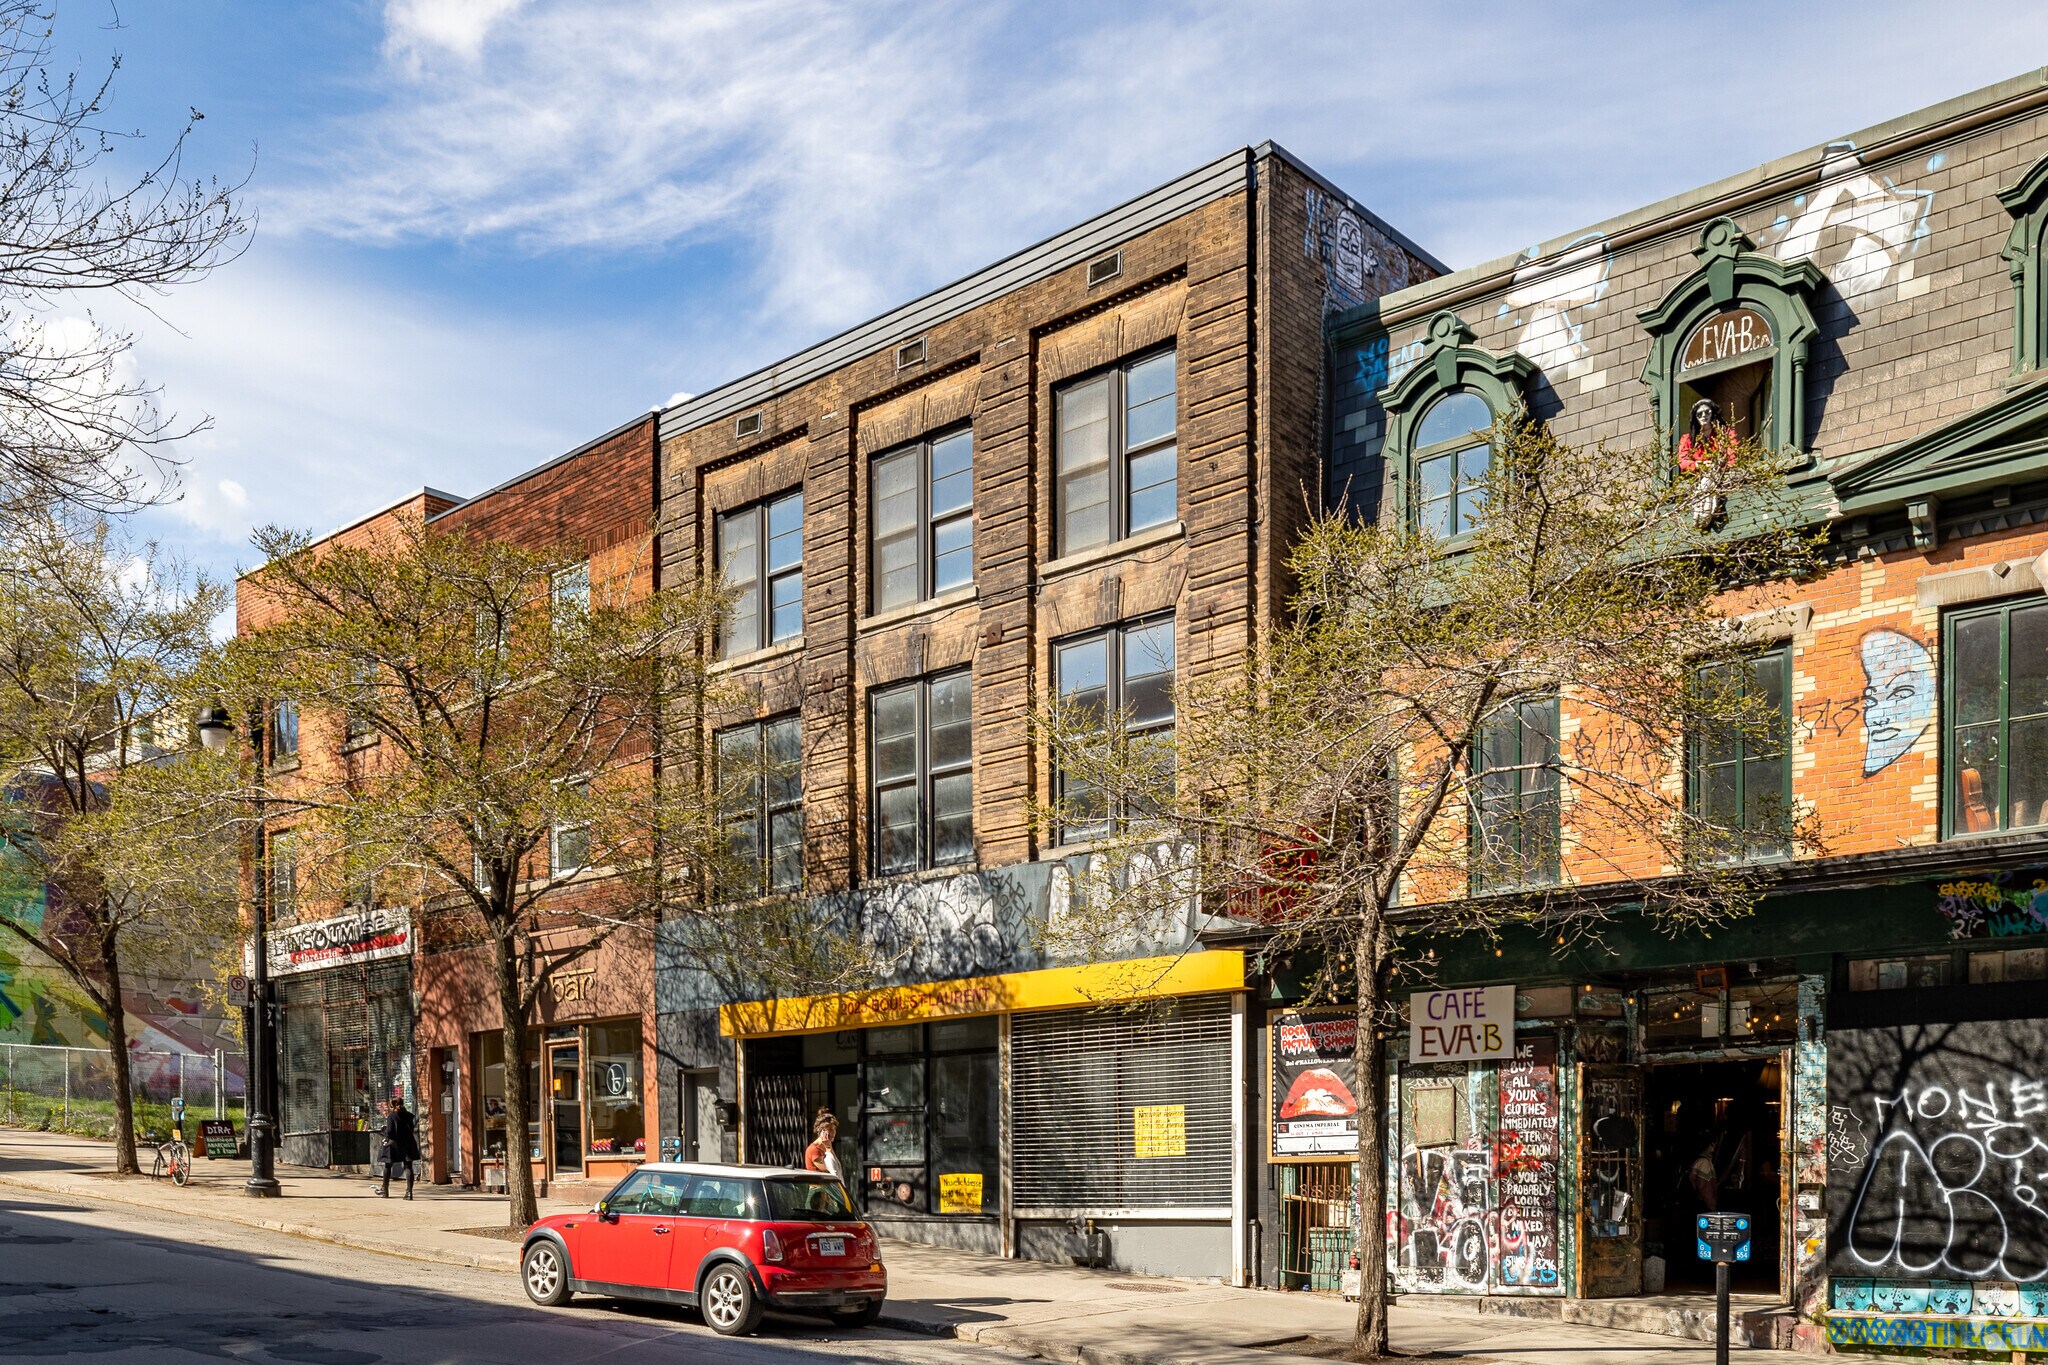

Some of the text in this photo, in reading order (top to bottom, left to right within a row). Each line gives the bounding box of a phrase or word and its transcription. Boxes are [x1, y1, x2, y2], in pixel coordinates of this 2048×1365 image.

[1427, 987, 1487, 1021] CAFÉ
[1280, 1018, 1358, 1041] ROCKY HORROR
[1280, 1031, 1356, 1055] PICTURE SHOW
[1515, 1044, 1535, 1060] WE
[1510, 1060, 1535, 1075] BUY
[1512, 1075, 1531, 1088] ALL
[1507, 1089, 1539, 1103] YOUR
[1504, 1102, 1548, 1116] CLOTHES
[1501, 1115, 1558, 1130] IMMEDIATELY
[207, 1126, 231, 1134] DIRA
[1517, 1171, 1538, 1184] YOU
[1507, 1183, 1551, 1196] PROBABLY
[1514, 1195, 1541, 1207] LOOK
[1926, 1321, 1978, 1347] TIME
